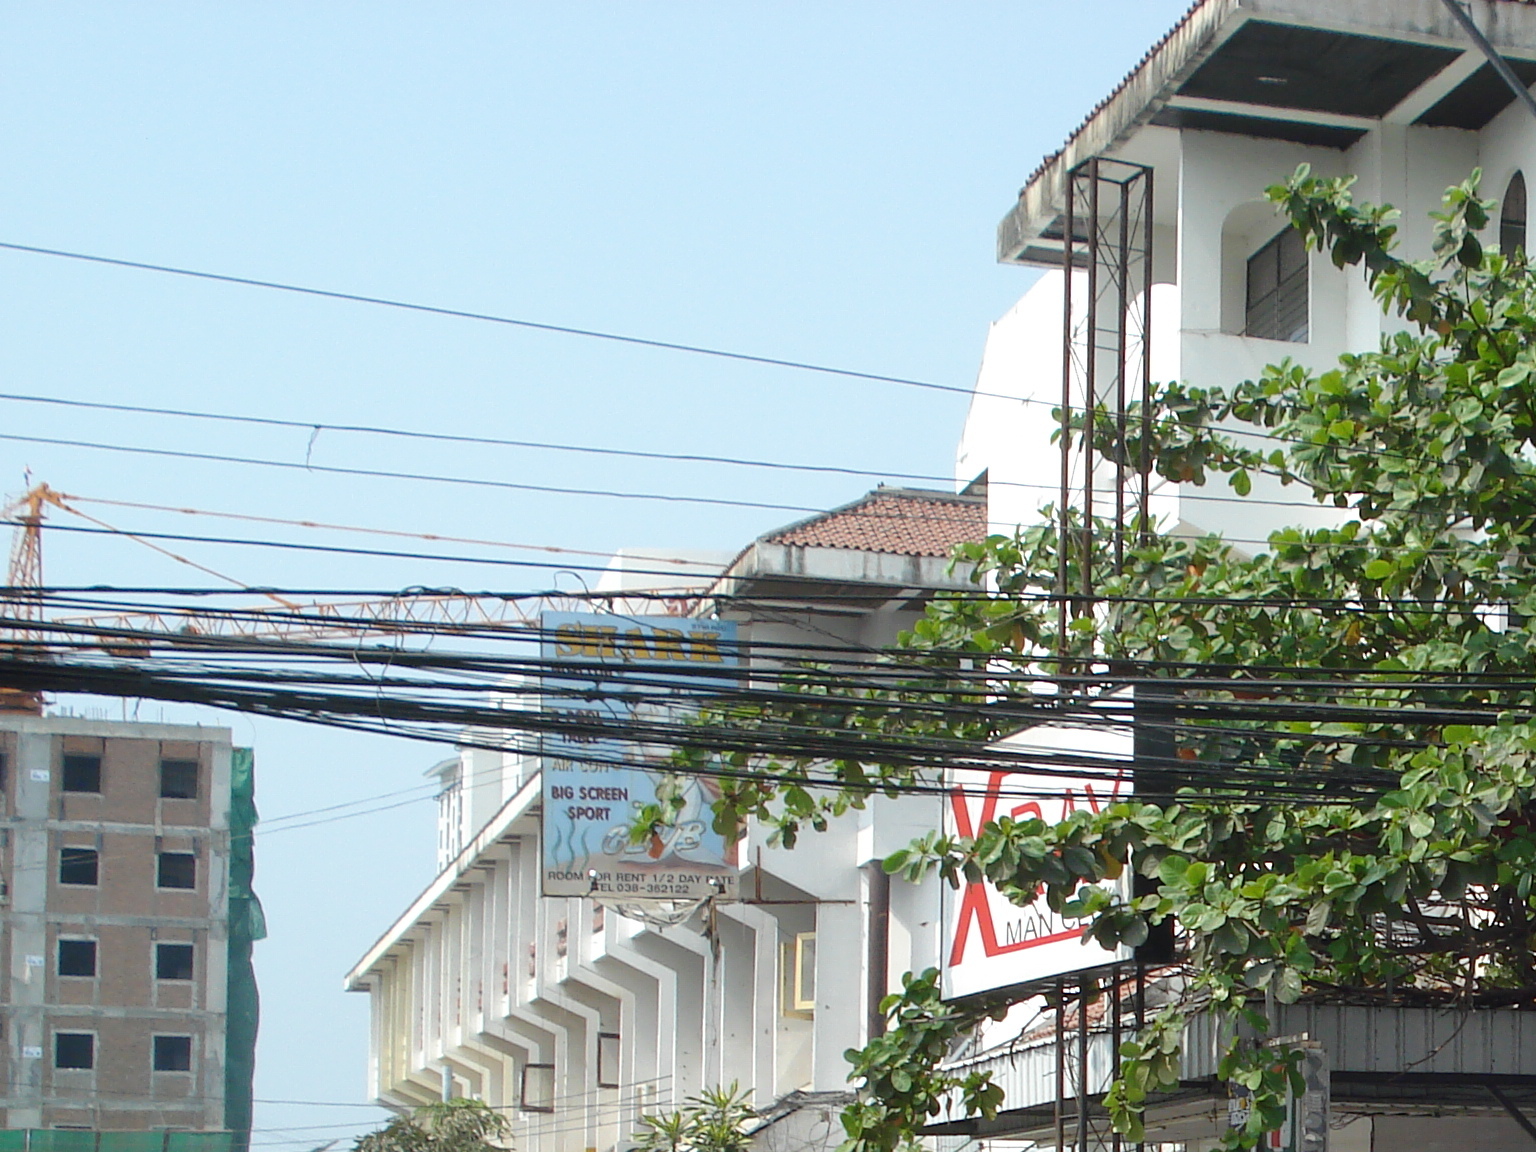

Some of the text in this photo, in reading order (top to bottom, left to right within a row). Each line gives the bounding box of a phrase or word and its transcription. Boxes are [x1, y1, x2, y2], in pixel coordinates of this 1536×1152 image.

[555, 620, 724, 663] SHARK
[551, 786, 628, 801] BIG SCREEN
[568, 806, 611, 821] SPORT
[548, 871, 583, 881] ROOM
[616, 873, 647, 883] RENT
[653, 874, 674, 883] 1/2
[679, 874, 702, 884] DAY
[1006, 911, 1053, 945] MAN
